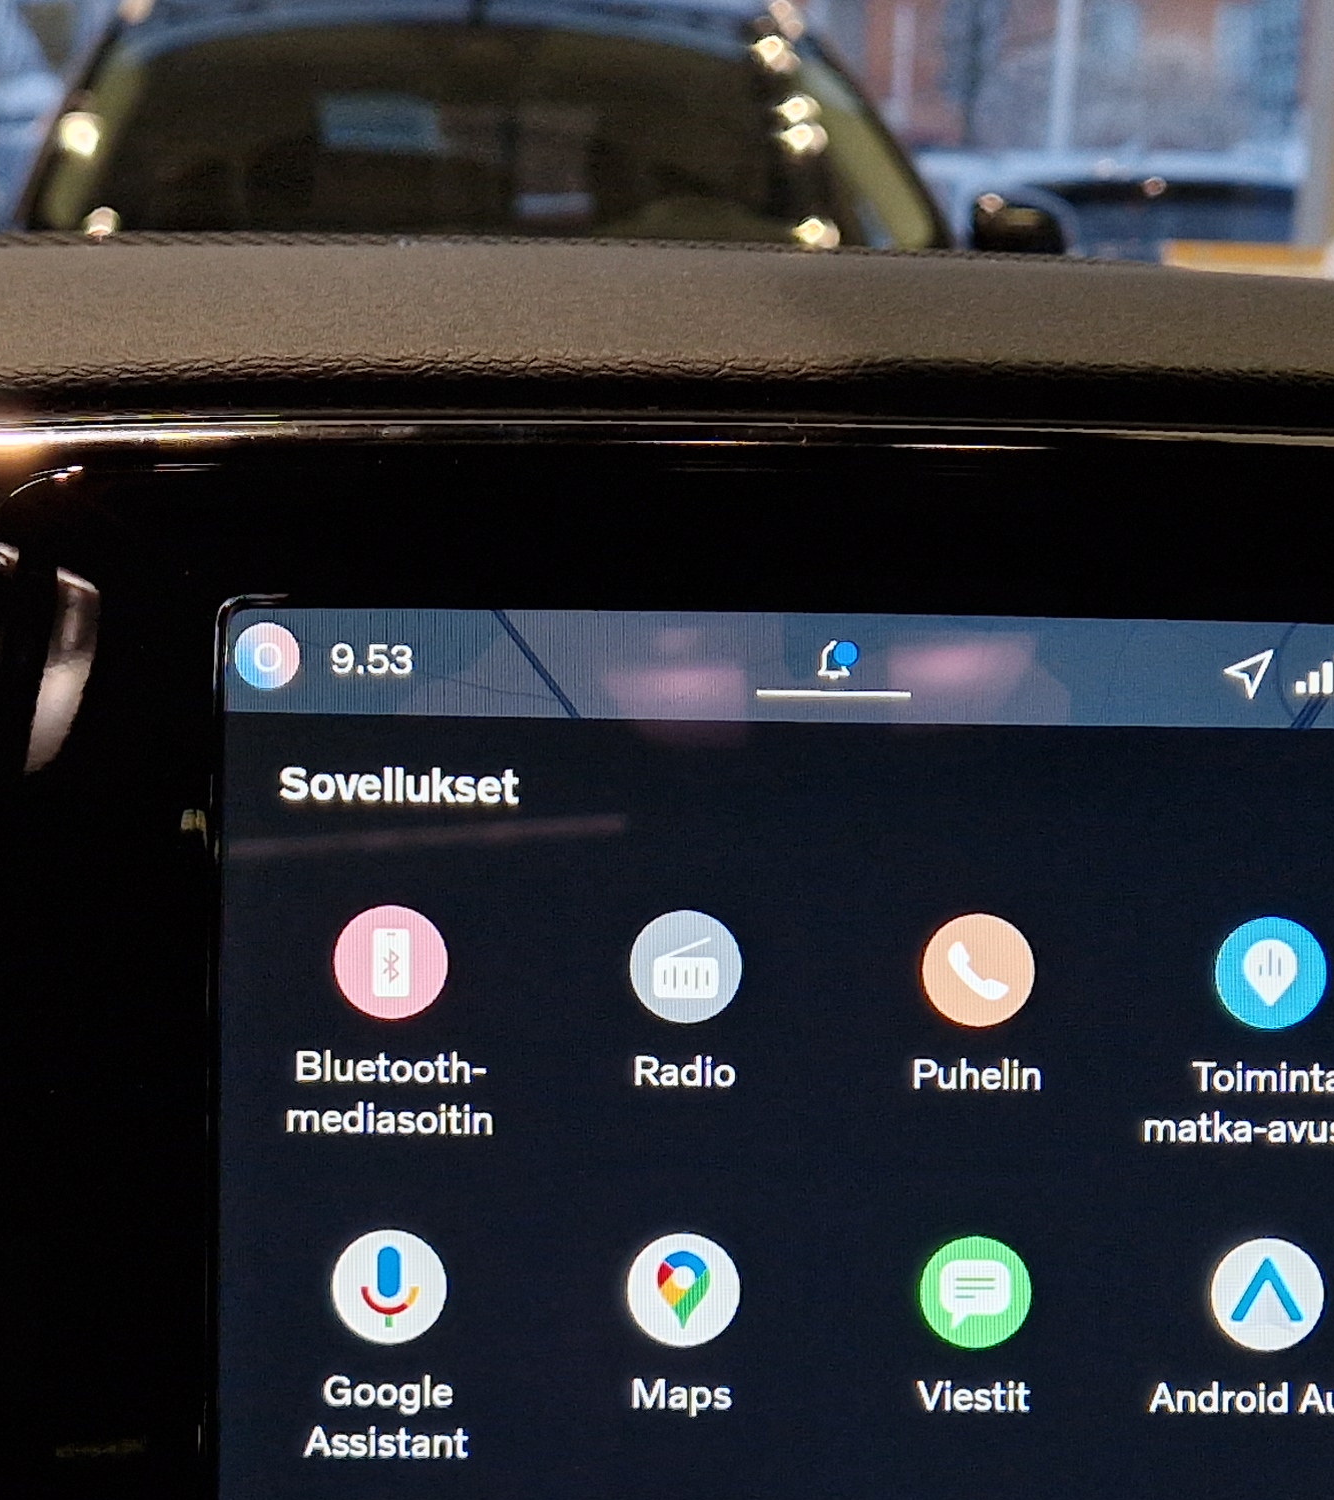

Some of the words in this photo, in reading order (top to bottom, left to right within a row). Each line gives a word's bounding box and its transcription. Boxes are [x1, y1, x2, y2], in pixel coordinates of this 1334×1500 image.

[330, 641, 414, 676] 9.53
[278, 765, 521, 807] Sovellukset
[295, 1048, 488, 1085] Bluetooth-
[633, 1053, 737, 1089] Radio
[912, 1056, 1043, 1092] Puhelin
[285, 1100, 494, 1137] mediasoitin
[322, 1373, 454, 1416] Google
[630, 1376, 733, 1419] Maps
[915, 1379, 1032, 1414] Viestit
[1147, 1379, 1290, 1415] Android
[302, 1424, 470, 1460] Assistant
